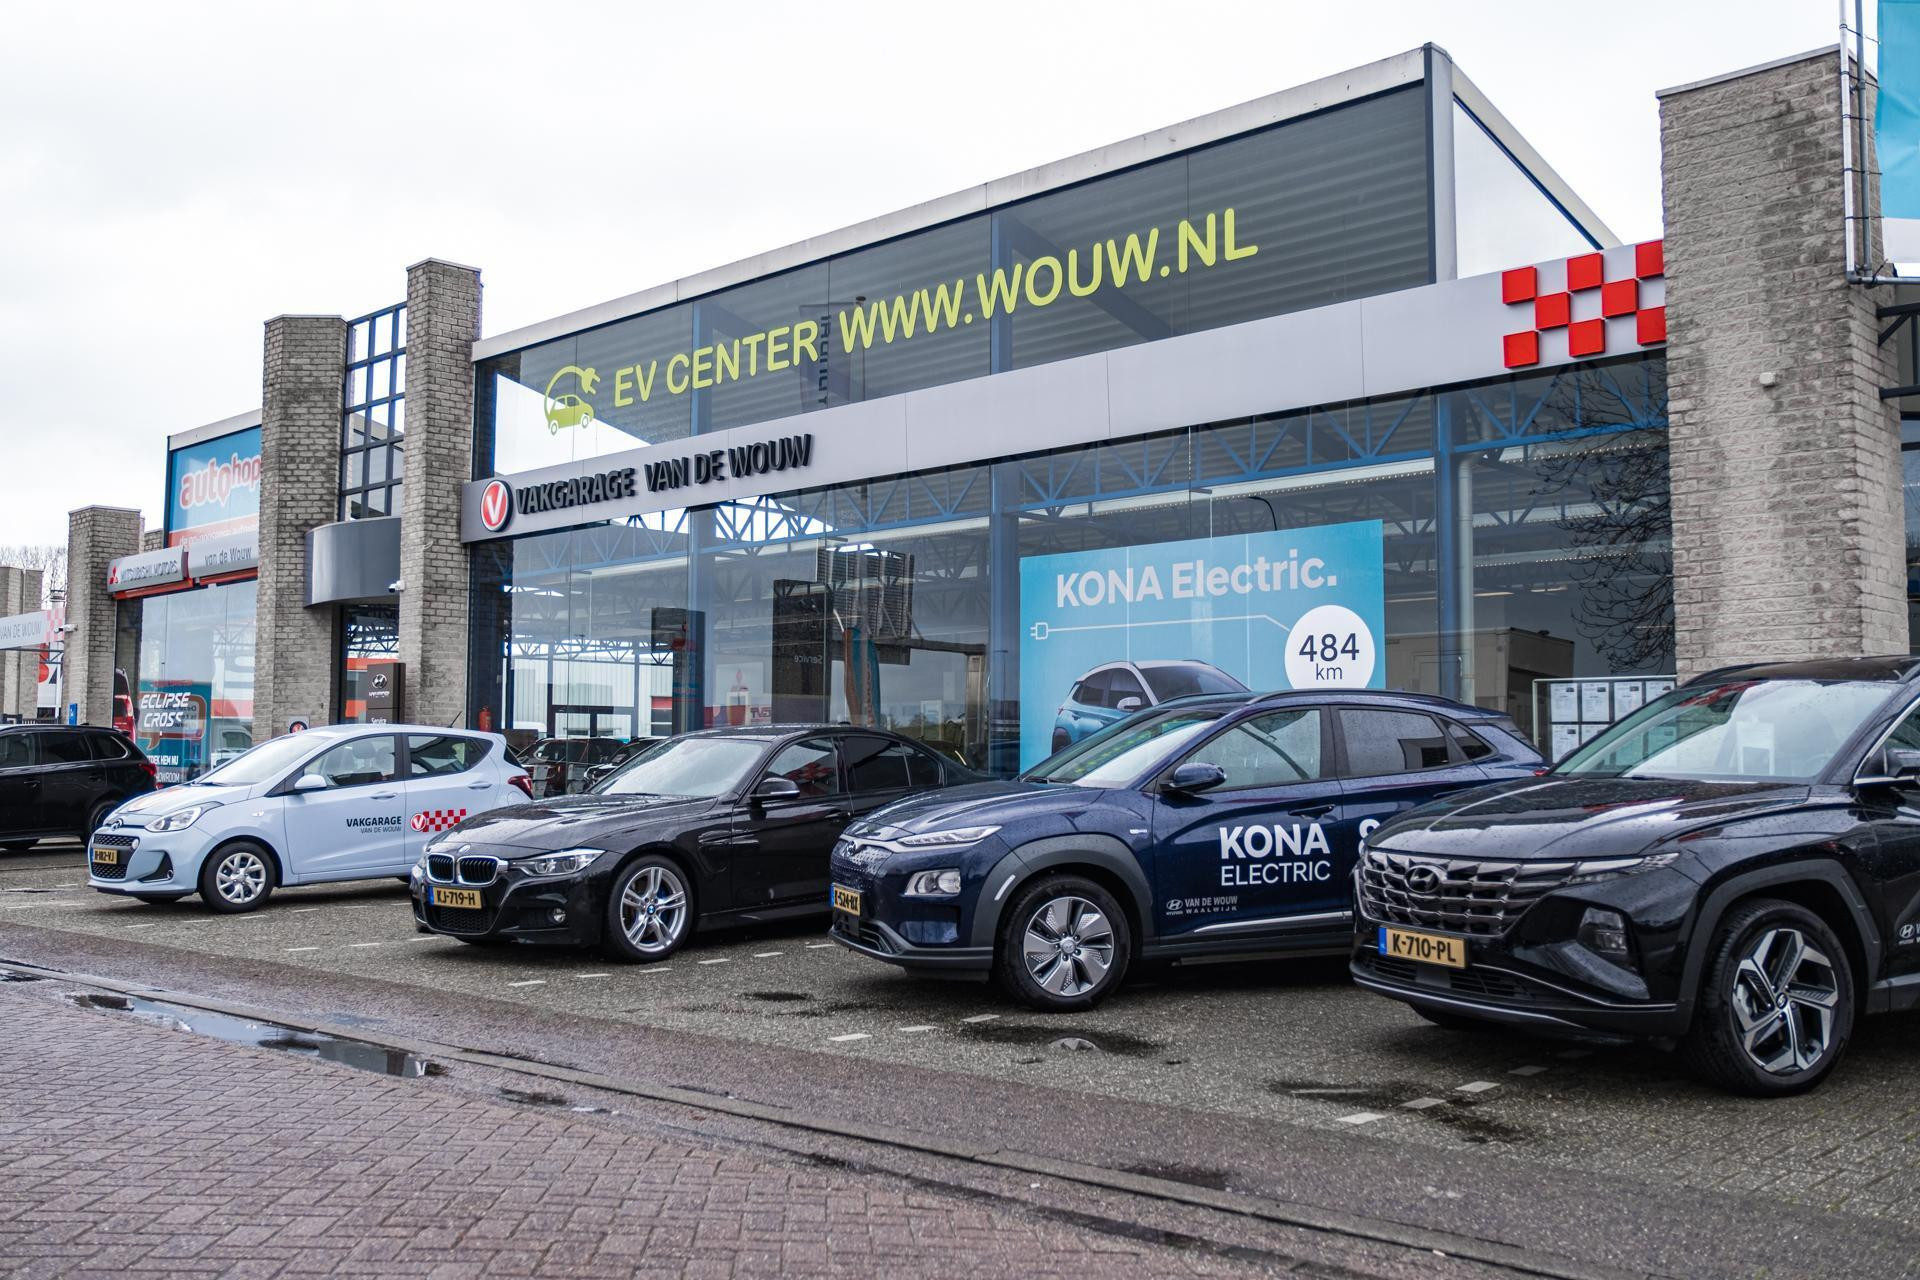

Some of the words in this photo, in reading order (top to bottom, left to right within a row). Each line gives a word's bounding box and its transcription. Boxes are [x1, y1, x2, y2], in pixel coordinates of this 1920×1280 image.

[614, 360, 657, 407] EV
[666, 320, 819, 394] CENTER
[839, 207, 1259, 354] WWW.WOUW.NL
[515, 467, 635, 515] VAKGARAGE
[644, 456, 690, 492] VAN
[694, 449, 724, 484] DE
[727, 433, 812, 478] WOUW
[229, 546, 252, 561] Wouw
[1056, 567, 1163, 608] KONA
[1171, 548, 1338, 599] Electric.
[1299, 632, 1360, 663] 484
[1315, 663, 1343, 681] km
[140, 691, 191, 709] ECLIPSE
[346, 816, 402, 827] VAKGARAGE
[1219, 822, 1331, 860] KONA
[1221, 860, 1331, 886] ELECTRIC
[1185, 898, 1200, 908] VAN
[1201, 897, 1212, 906] DE
[1213, 895, 1238, 905] WOUW
[1392, 933, 1457, 963] K-710-PL
